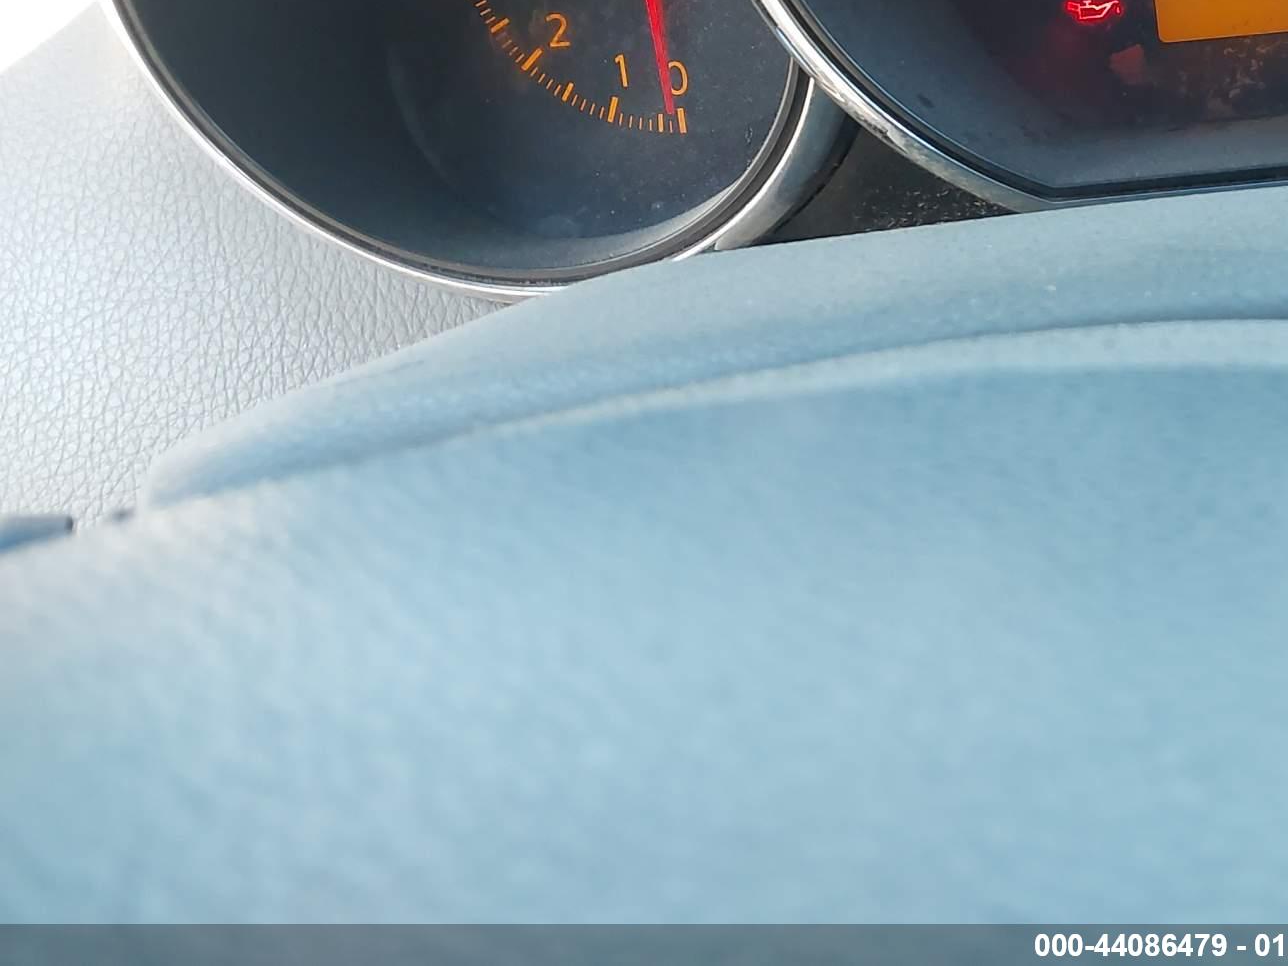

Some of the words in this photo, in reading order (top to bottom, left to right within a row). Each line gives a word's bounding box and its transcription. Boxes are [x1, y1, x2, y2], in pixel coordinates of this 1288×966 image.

[546, 13, 571, 48] 2
[614, 54, 628, 88] 1
[665, 60, 689, 95] 0
